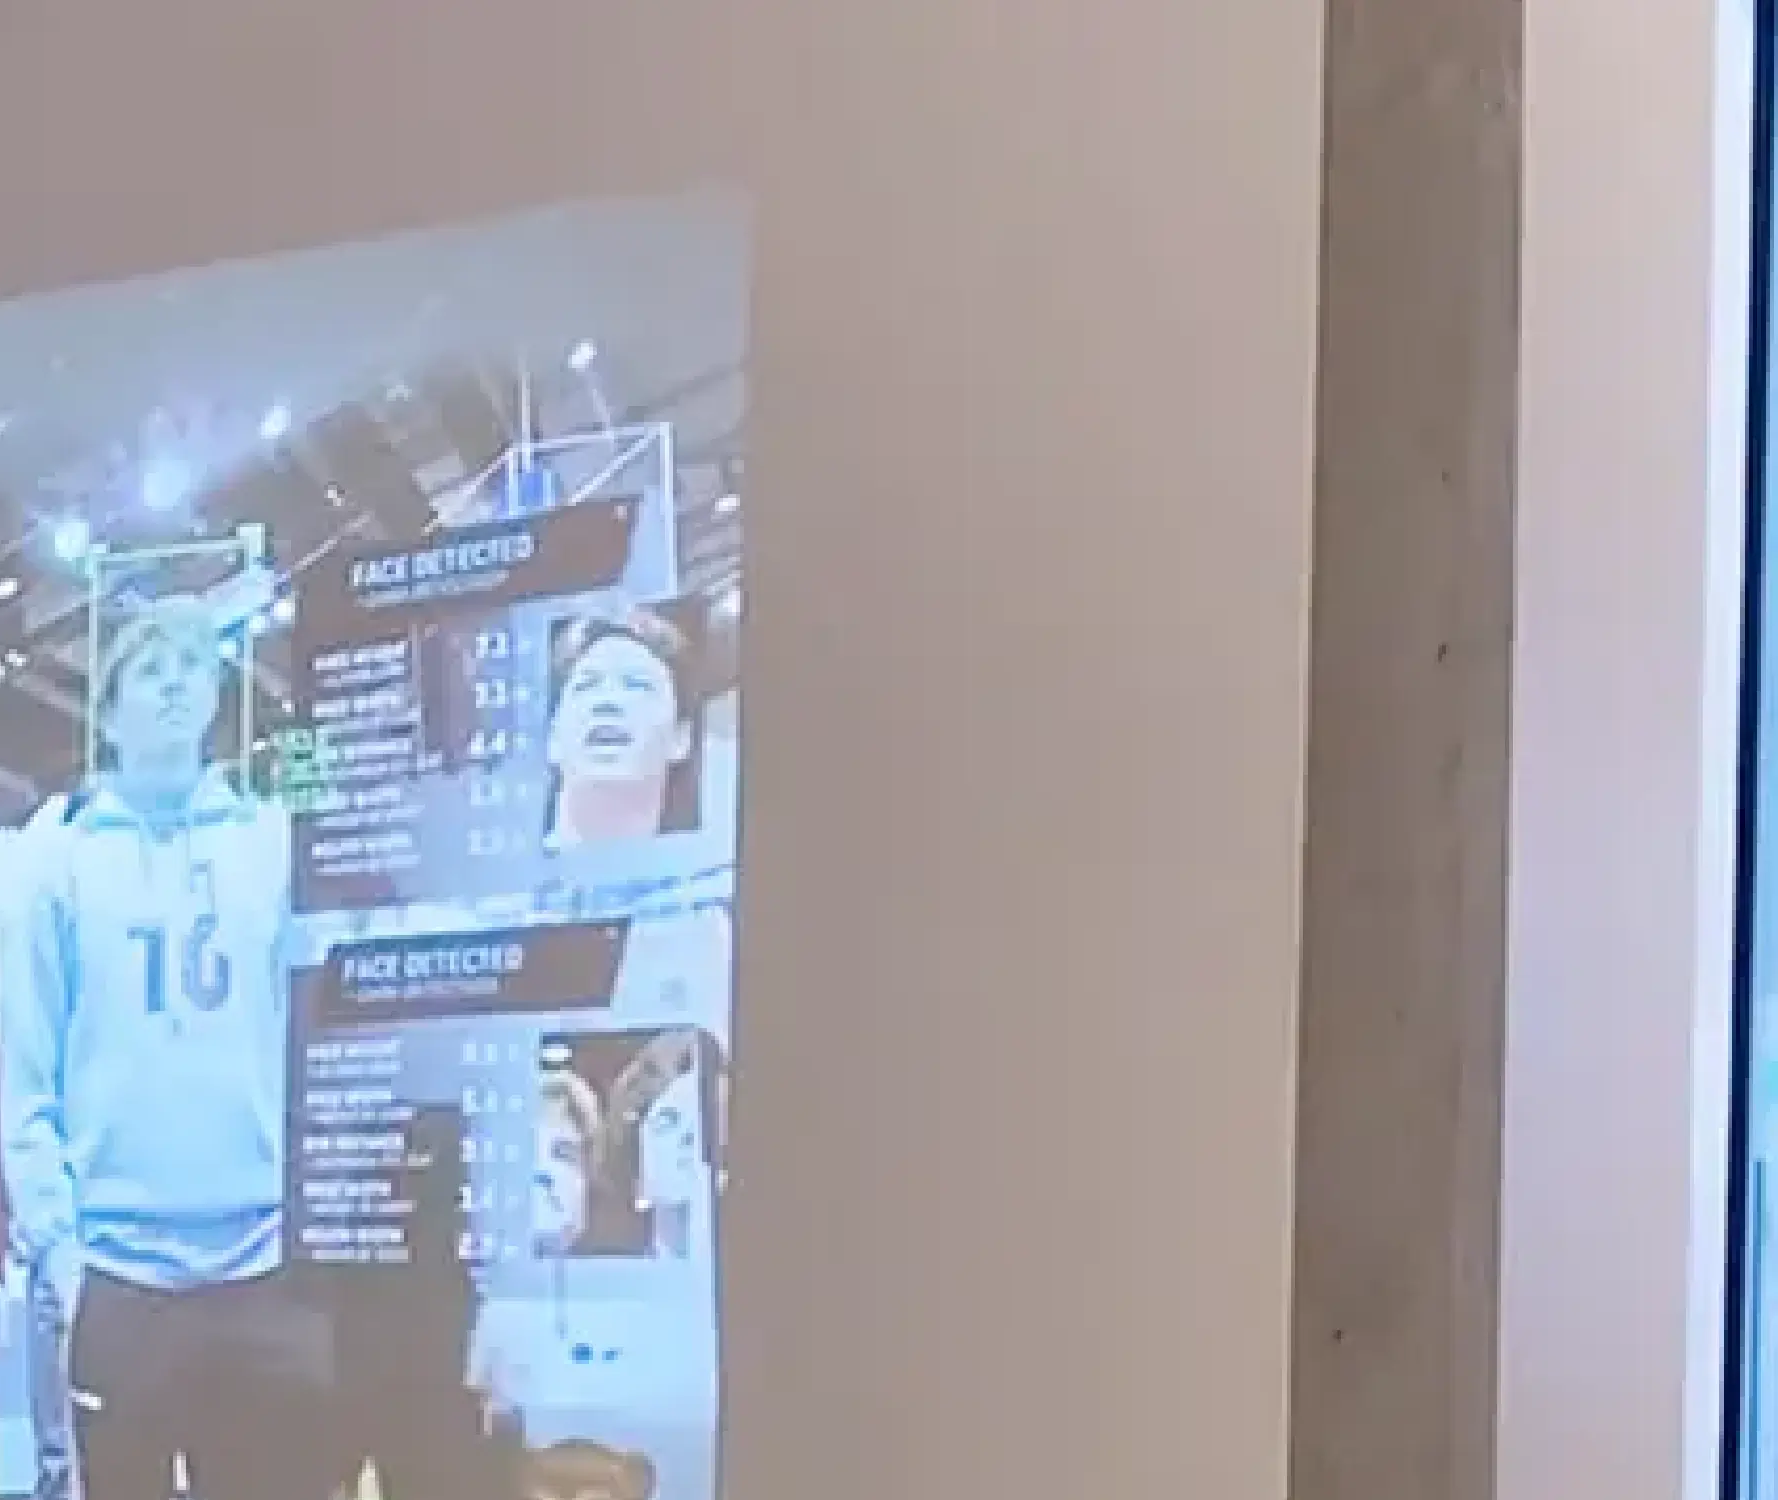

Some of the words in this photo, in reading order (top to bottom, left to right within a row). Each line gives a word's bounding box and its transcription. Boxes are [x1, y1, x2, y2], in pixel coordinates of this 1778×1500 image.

[125, 911, 233, 1013] 16
[343, 947, 403, 982] FACE
[404, 941, 525, 980] DETECTED
